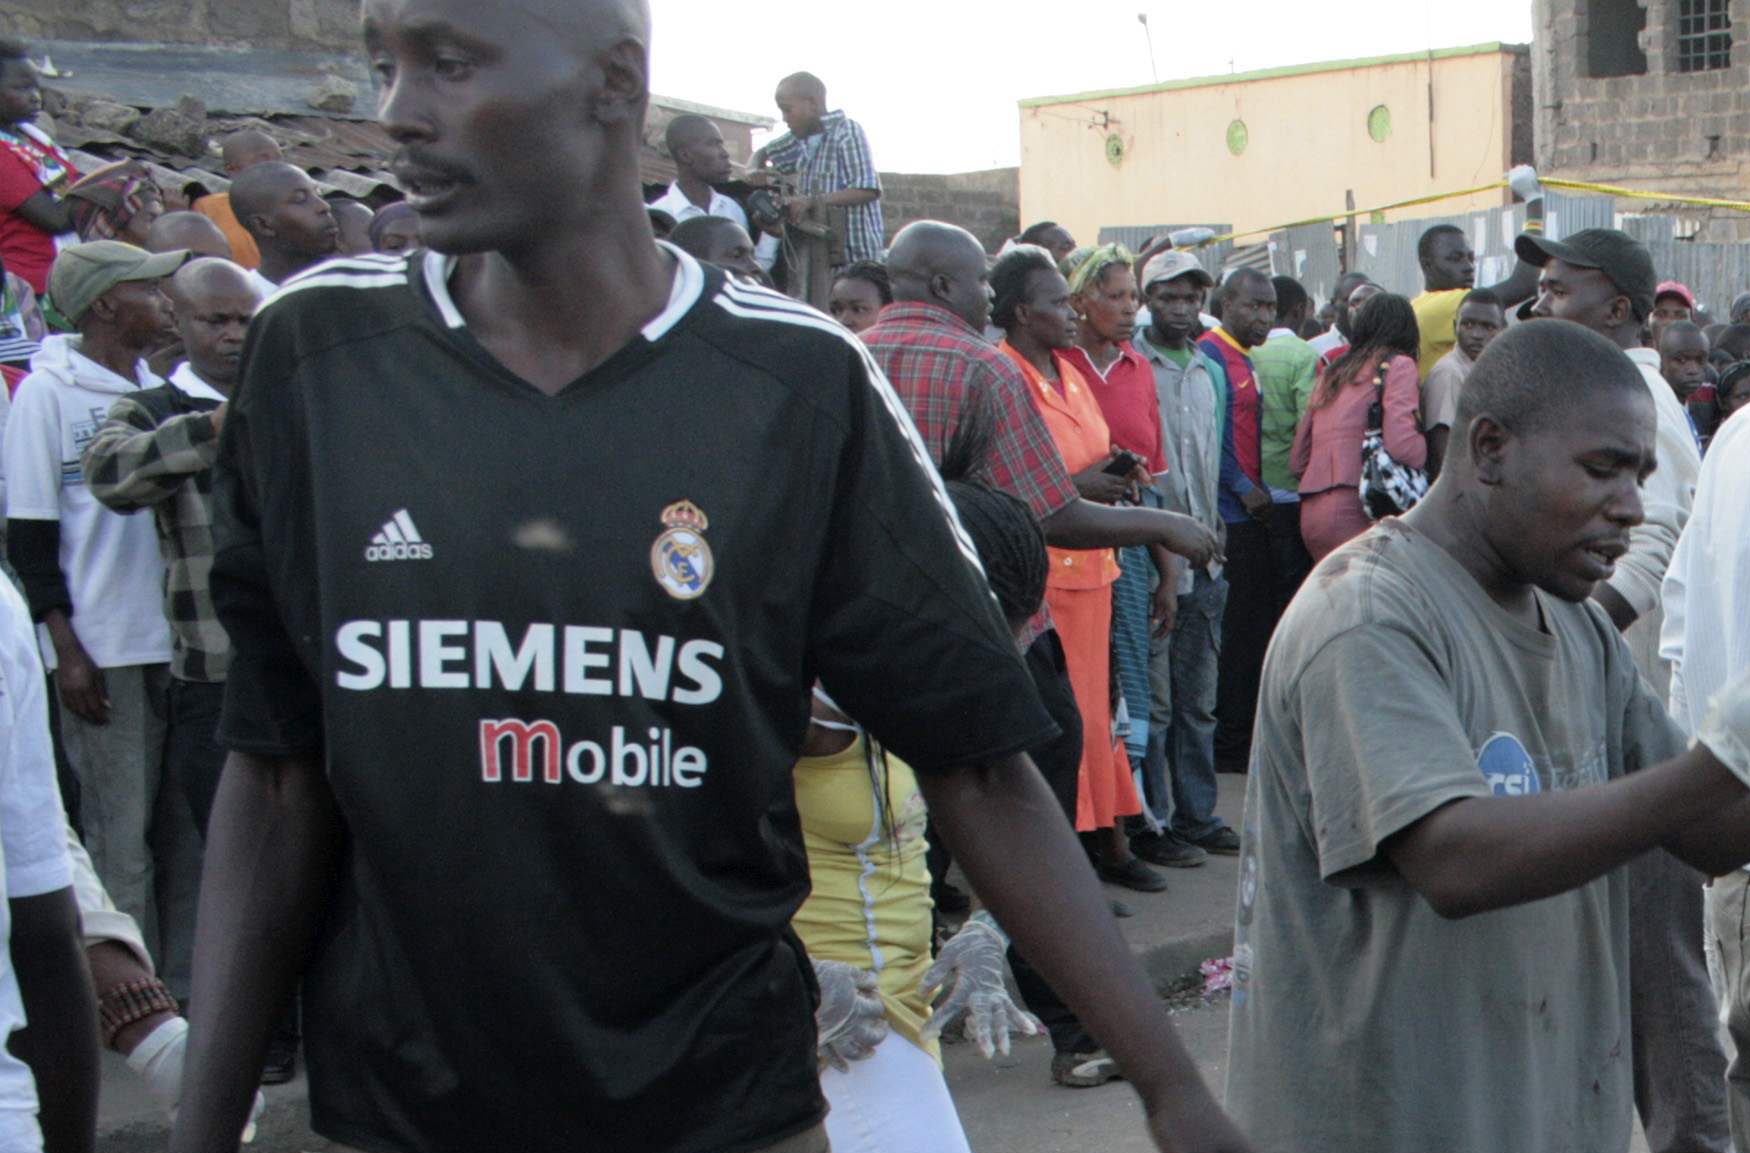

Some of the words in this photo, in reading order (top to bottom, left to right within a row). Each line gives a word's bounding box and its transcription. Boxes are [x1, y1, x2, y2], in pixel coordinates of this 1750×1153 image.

[365, 541, 433, 561] adidas
[336, 620, 725, 705] SIEMENS
[480, 718, 707, 788] mobile
